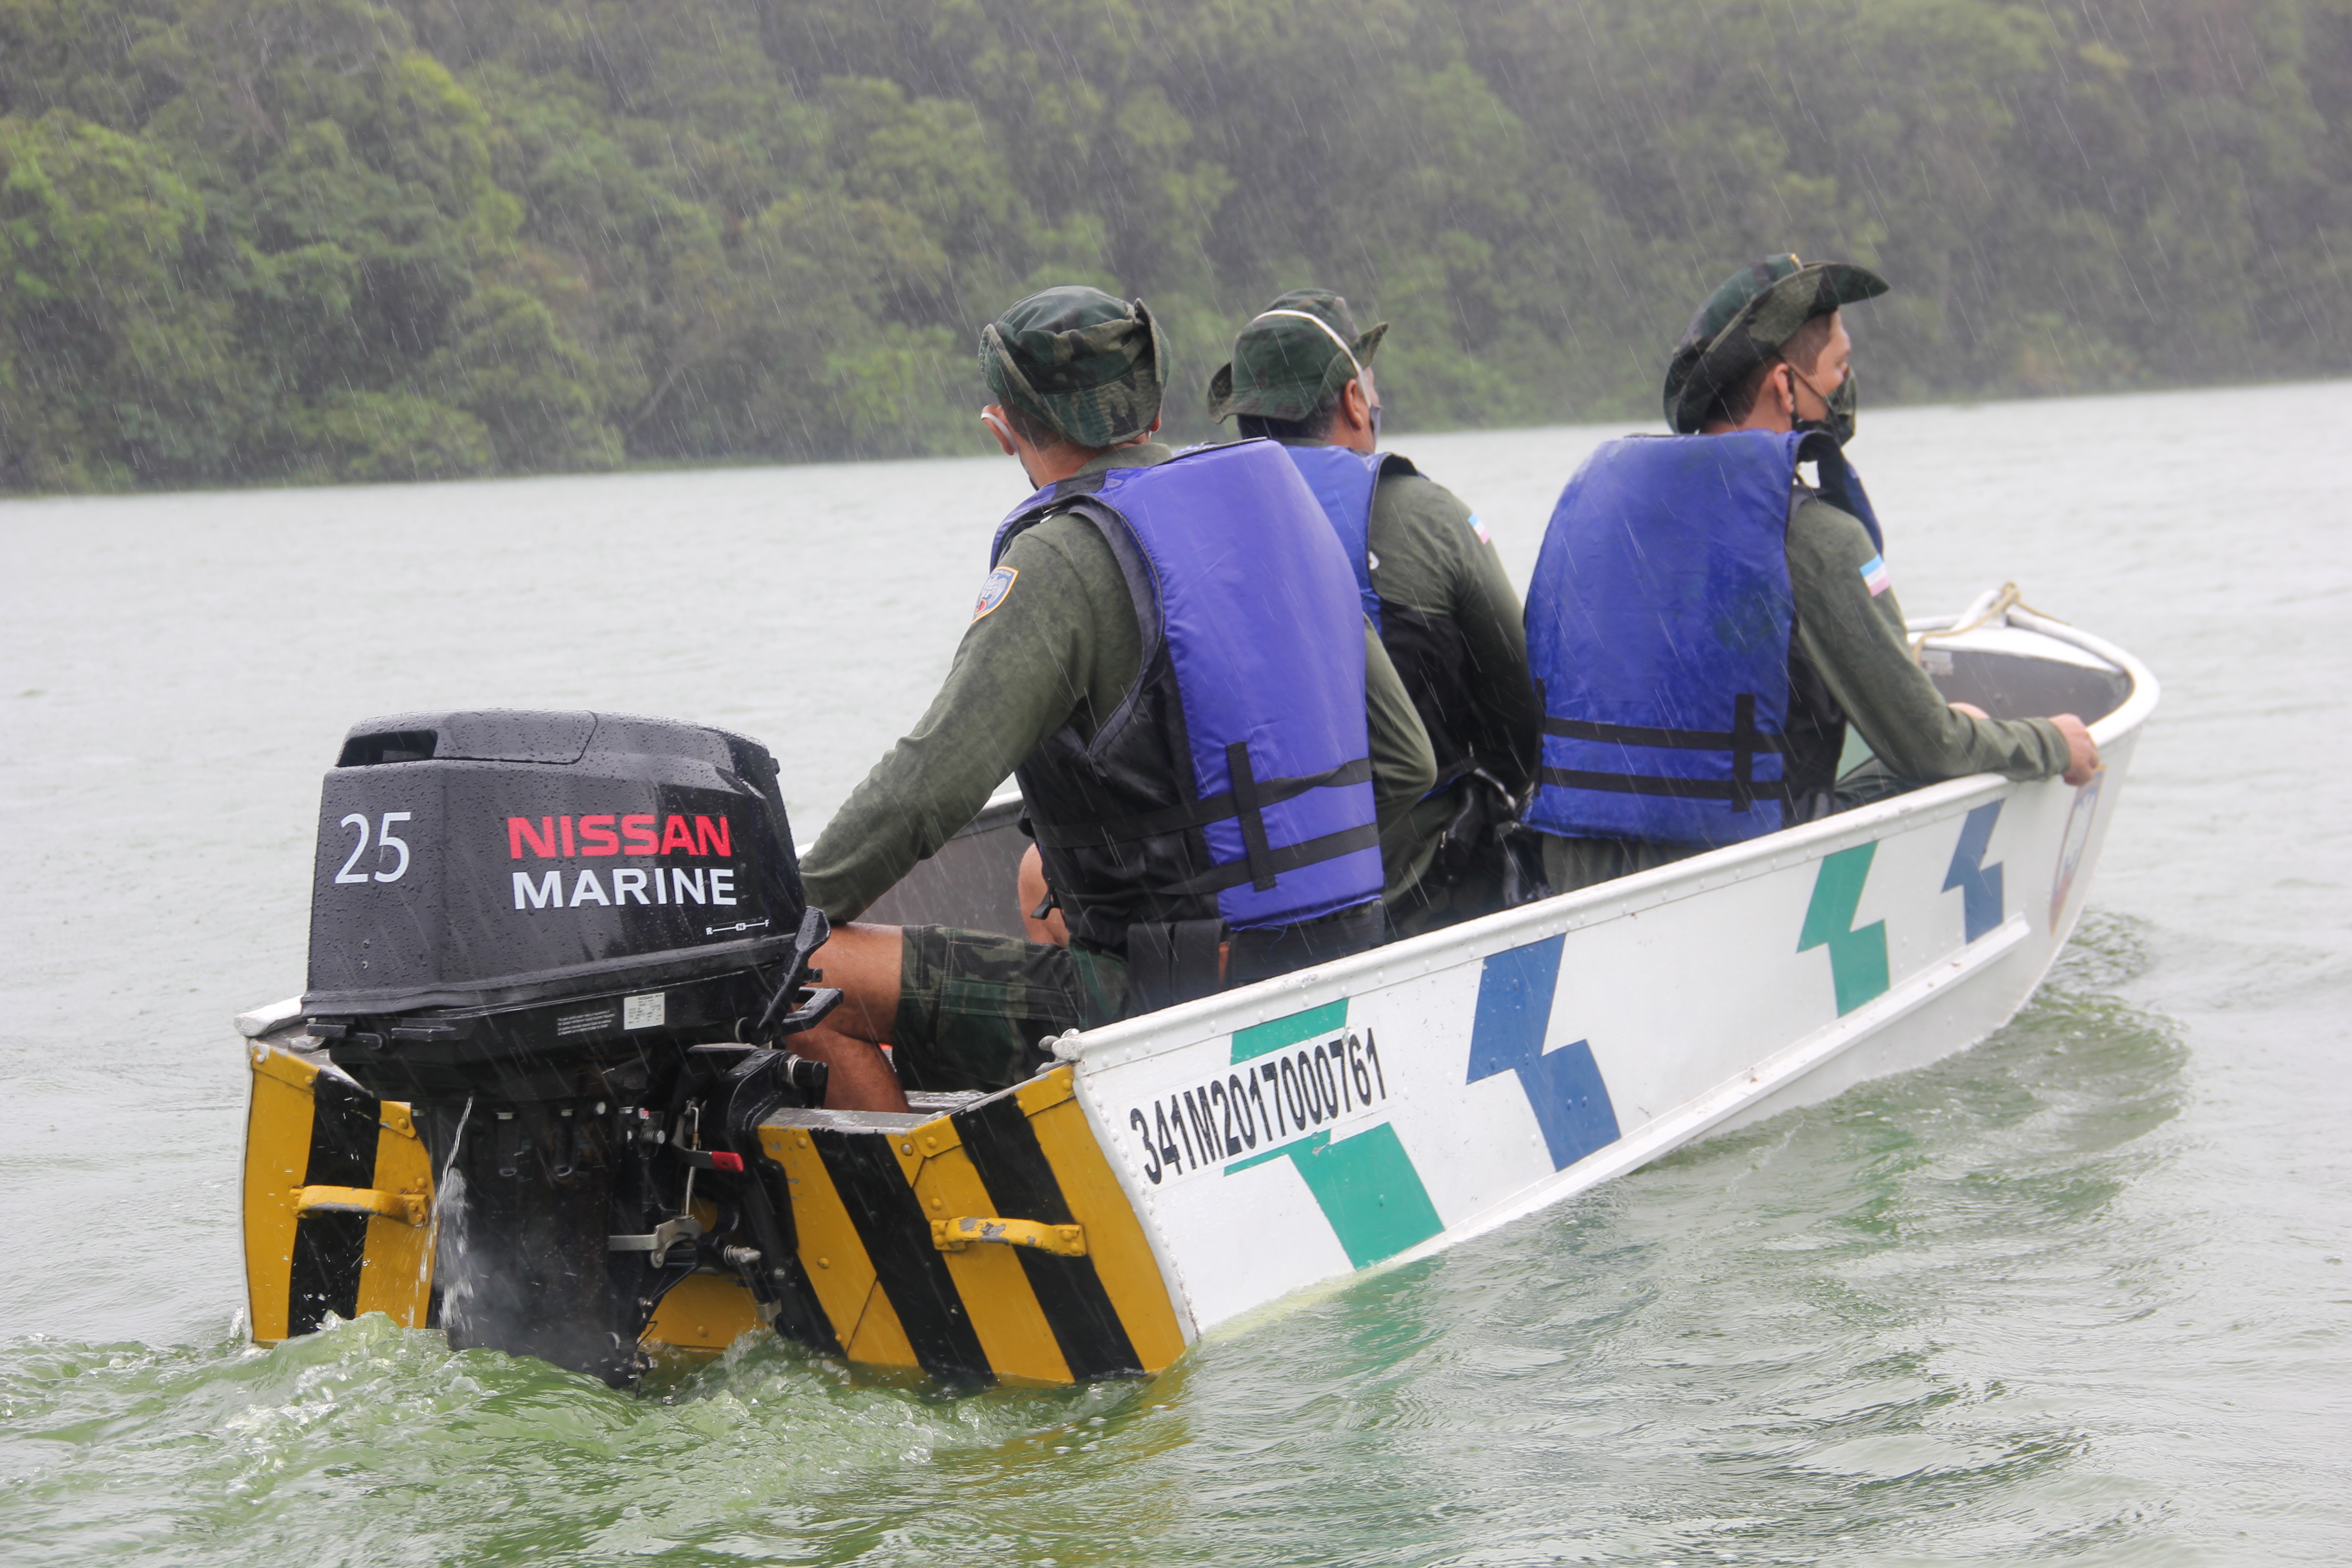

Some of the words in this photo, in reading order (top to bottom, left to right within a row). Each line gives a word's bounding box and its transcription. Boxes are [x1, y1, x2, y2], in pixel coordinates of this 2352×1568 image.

[335, 812, 411, 883] 25
[507, 814, 732, 859] NISSAN
[512, 868, 737, 910] MARINE
[706, 927, 713, 935] R
[1130, 1028, 1387, 1185] 341M2017000761
